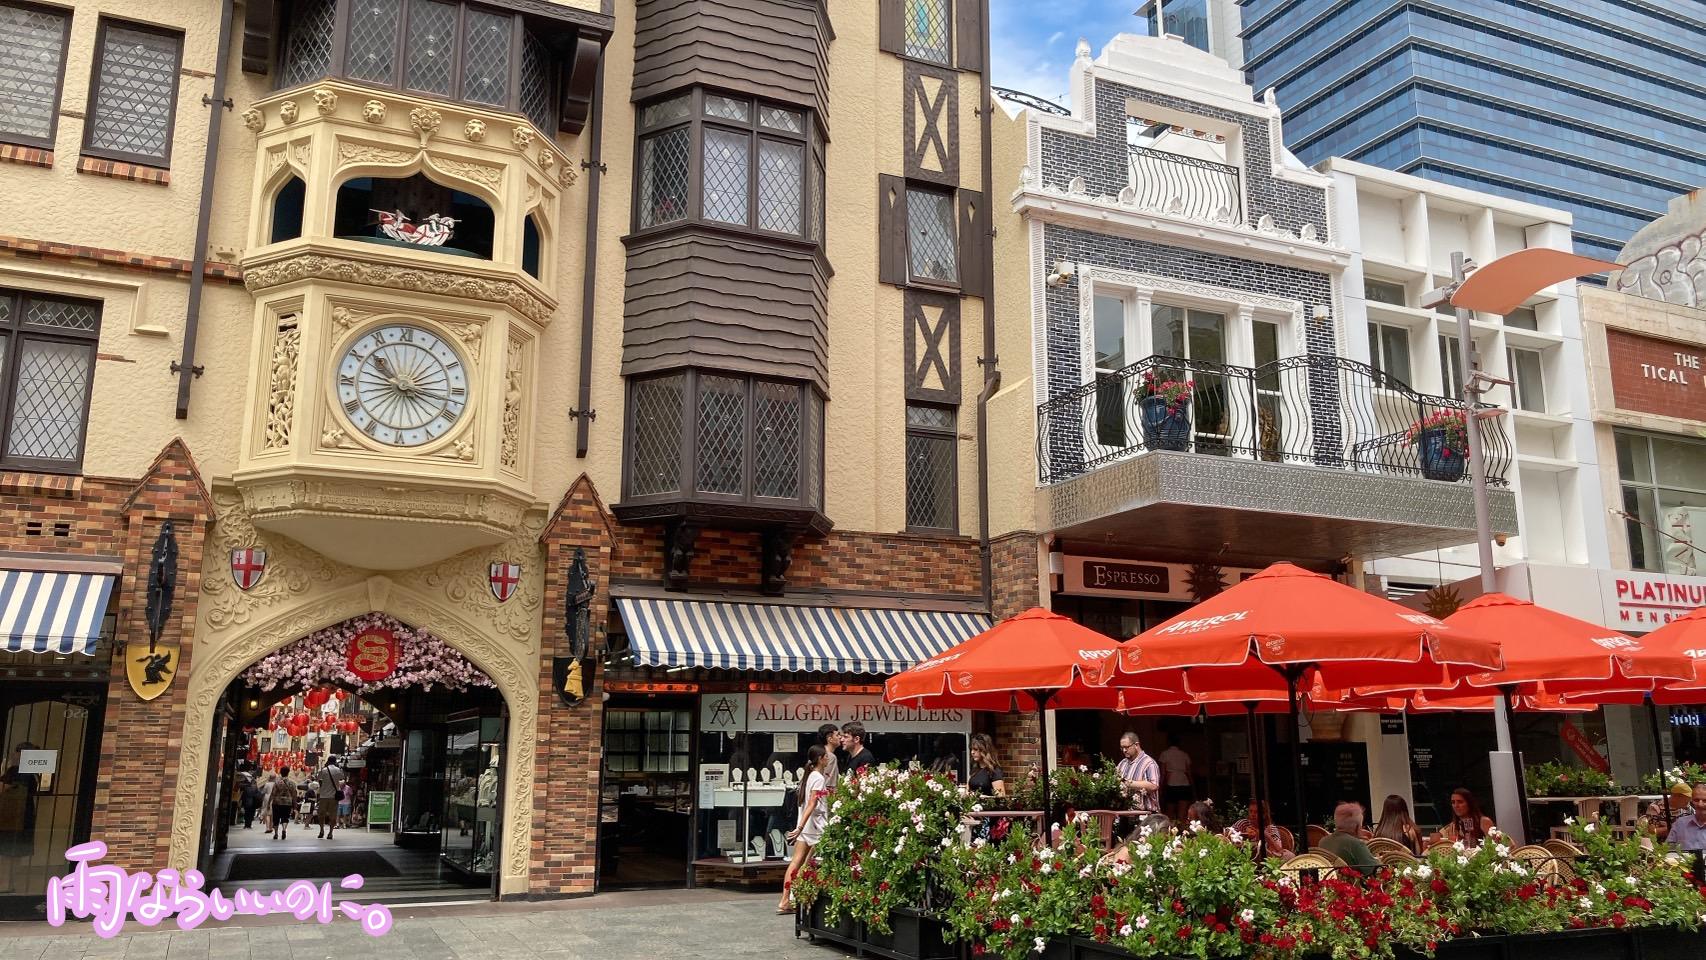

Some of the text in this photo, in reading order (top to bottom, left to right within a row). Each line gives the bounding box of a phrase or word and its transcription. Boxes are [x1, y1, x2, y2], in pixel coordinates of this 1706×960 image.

[1673, 352, 1700, 369] THE
[1641, 363, 1688, 385] TICAL
[1093, 565, 1160, 586] ESPRESSO
[1616, 579, 1706, 604] PLATINU
[1154, 611, 1250, 635] APEROL
[1619, 610, 1682, 624] MENS
[754, 703, 963, 722] ALLGEM JEWELLERS
